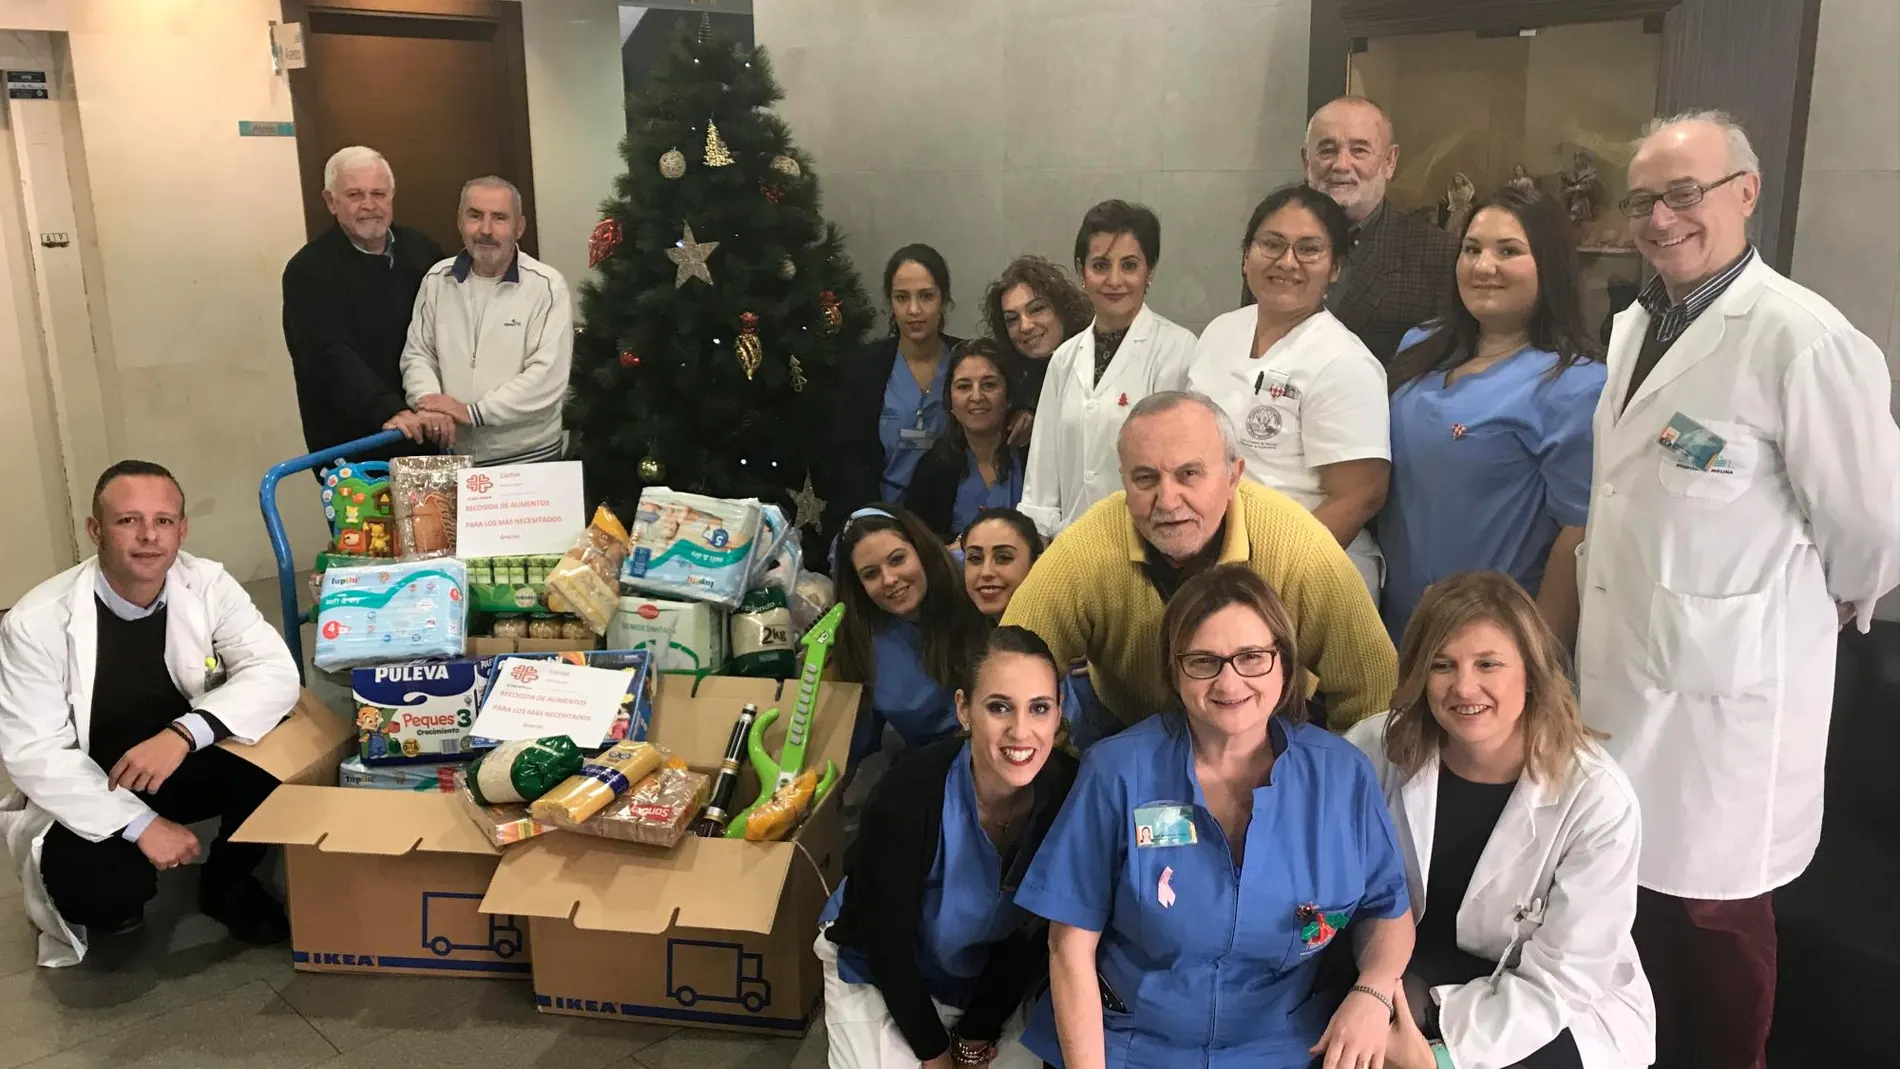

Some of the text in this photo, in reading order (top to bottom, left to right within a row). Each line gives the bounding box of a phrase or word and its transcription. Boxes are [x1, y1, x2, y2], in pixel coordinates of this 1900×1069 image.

[465, 503, 499, 512] RECOGIDA
[510, 499, 550, 509] ALIMENTOS
[465, 516, 562, 529] PARA LOS MÁS NECESITADOS
[714, 535, 724, 546] 5
[328, 623, 335, 634] 4
[375, 665, 449, 683] PULEVA
[500, 690, 535, 701] RECOGIDA
[536, 695, 546, 703] DE
[546, 696, 587, 706] ALIMENTOS
[402, 709, 471, 729] Peques 3
[492, 704, 511, 714] PARA
[512, 706, 526, 715] LOS
[544, 711, 591, 721] NECESITADOS
[416, 728, 460, 736] Crecimiento
[313, 953, 374, 966] IKEA
[556, 997, 617, 1014] IKEA
